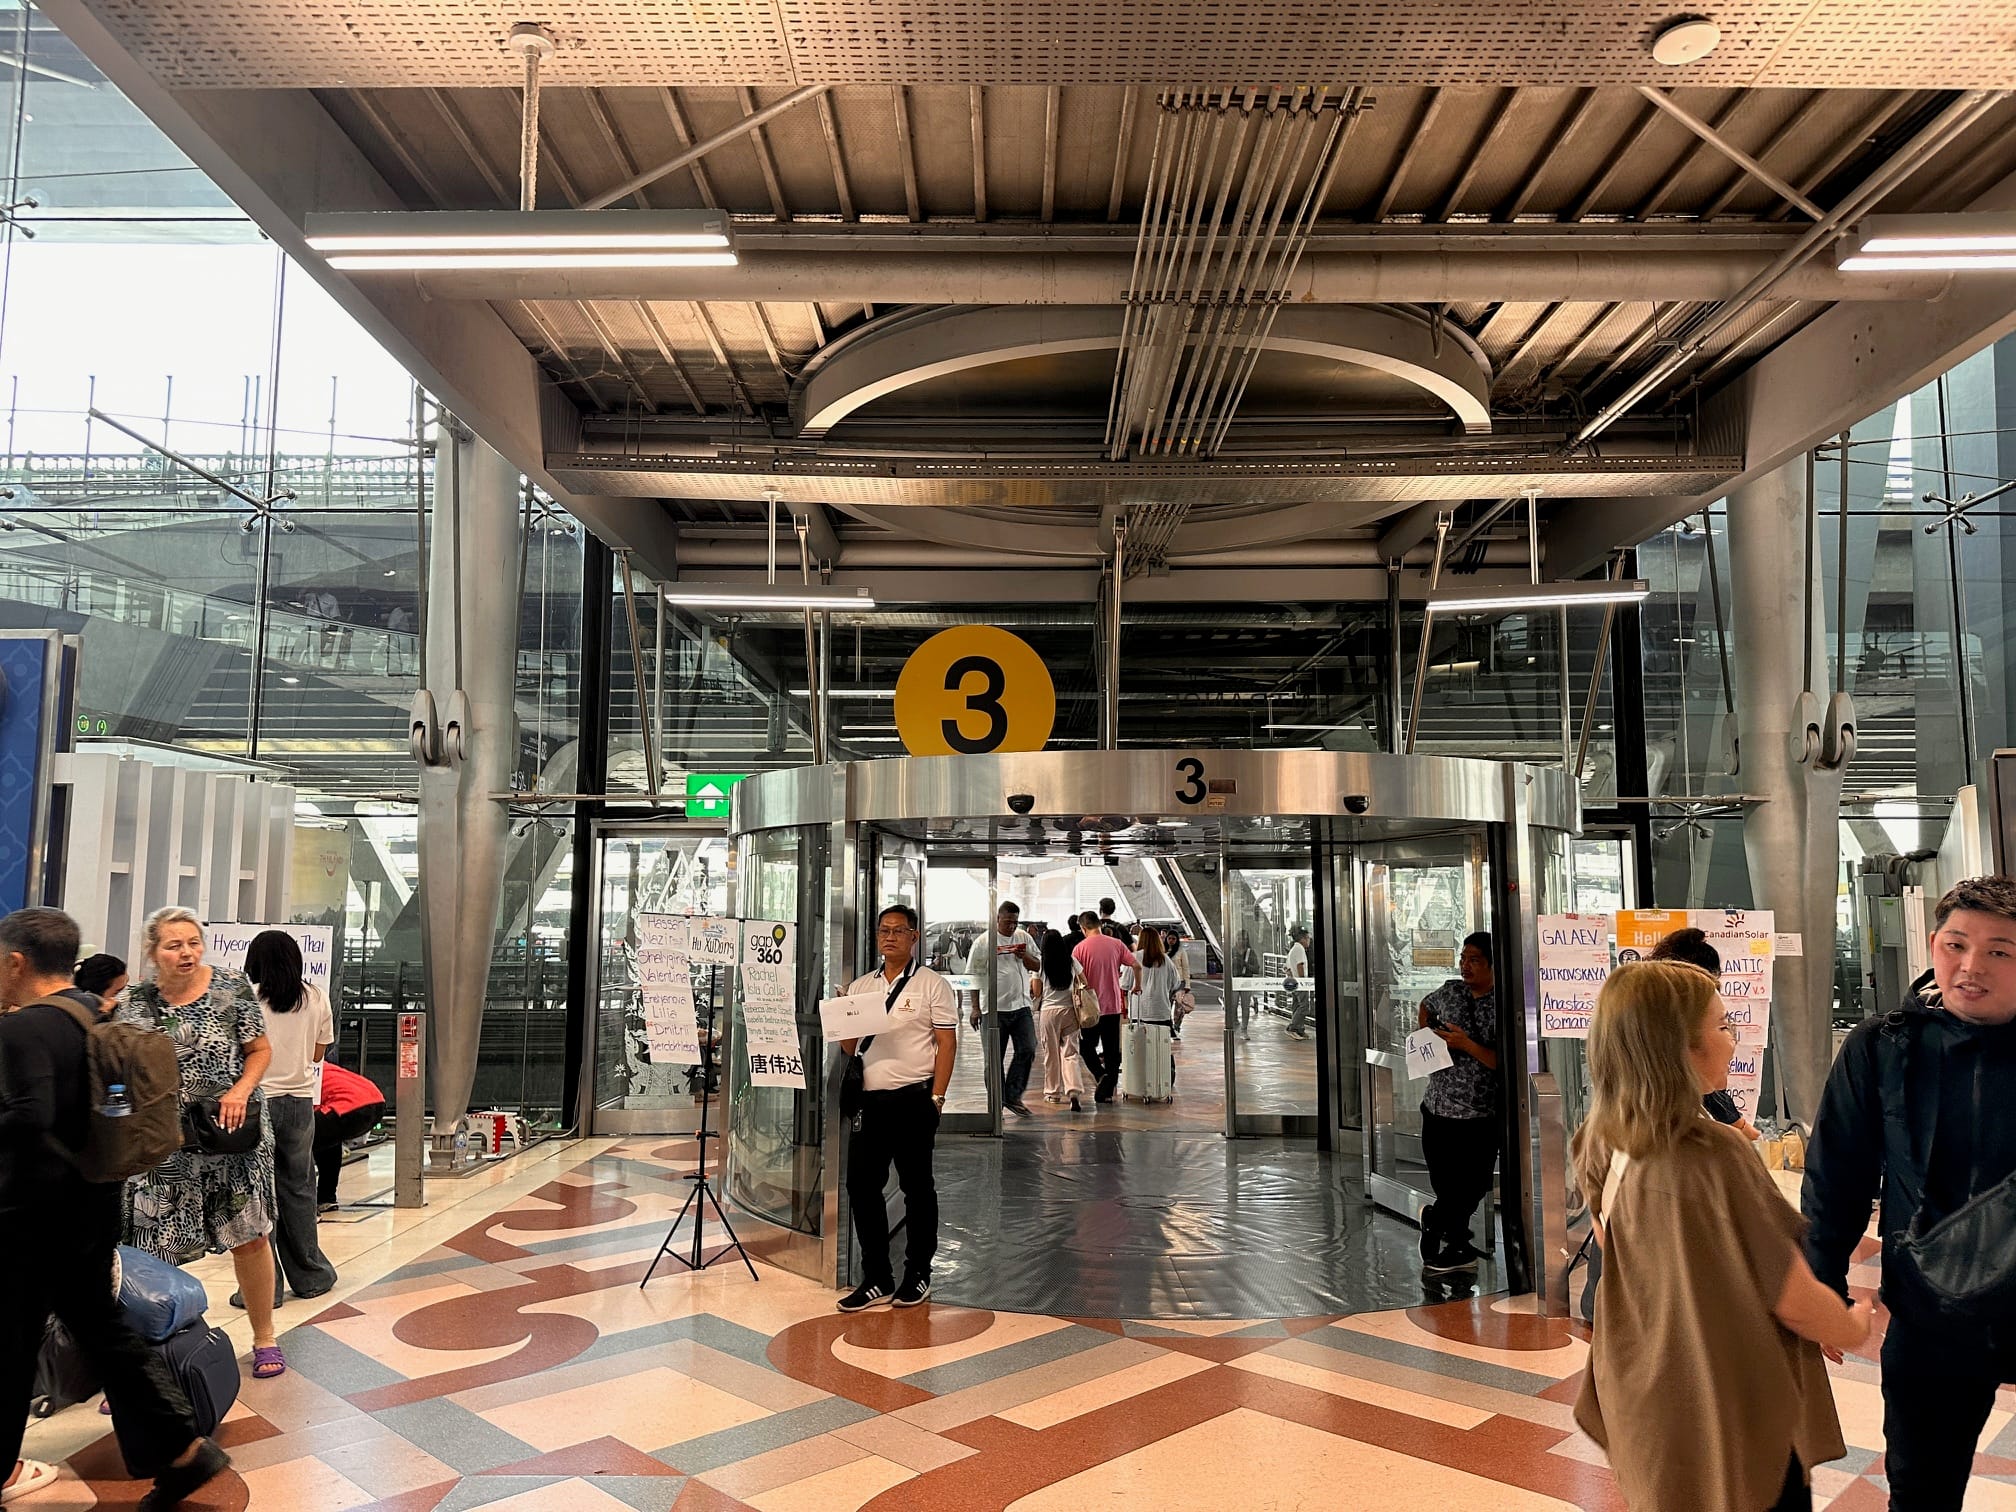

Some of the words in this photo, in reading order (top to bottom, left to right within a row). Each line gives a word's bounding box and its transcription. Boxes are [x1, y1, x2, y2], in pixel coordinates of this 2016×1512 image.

[941, 655, 1008, 755] 3
[1175, 757, 1207, 805] 3
[301, 934, 325, 953] Thai
[750, 935, 773, 951] gap
[1542, 929, 1598, 945] GALAEV
[1634, 931, 1662, 945] Hell
[757, 948, 783, 965] 360
[1539, 967, 1607, 981] BUTKOVSKAYA
[1722, 981, 1751, 997] ORY
[1543, 992, 1595, 1010] Anastas
[652, 1005, 678, 1019] Lilia
[750, 1054, 804, 1076] 唐伟达
[1728, 1057, 1755, 1074] eland
